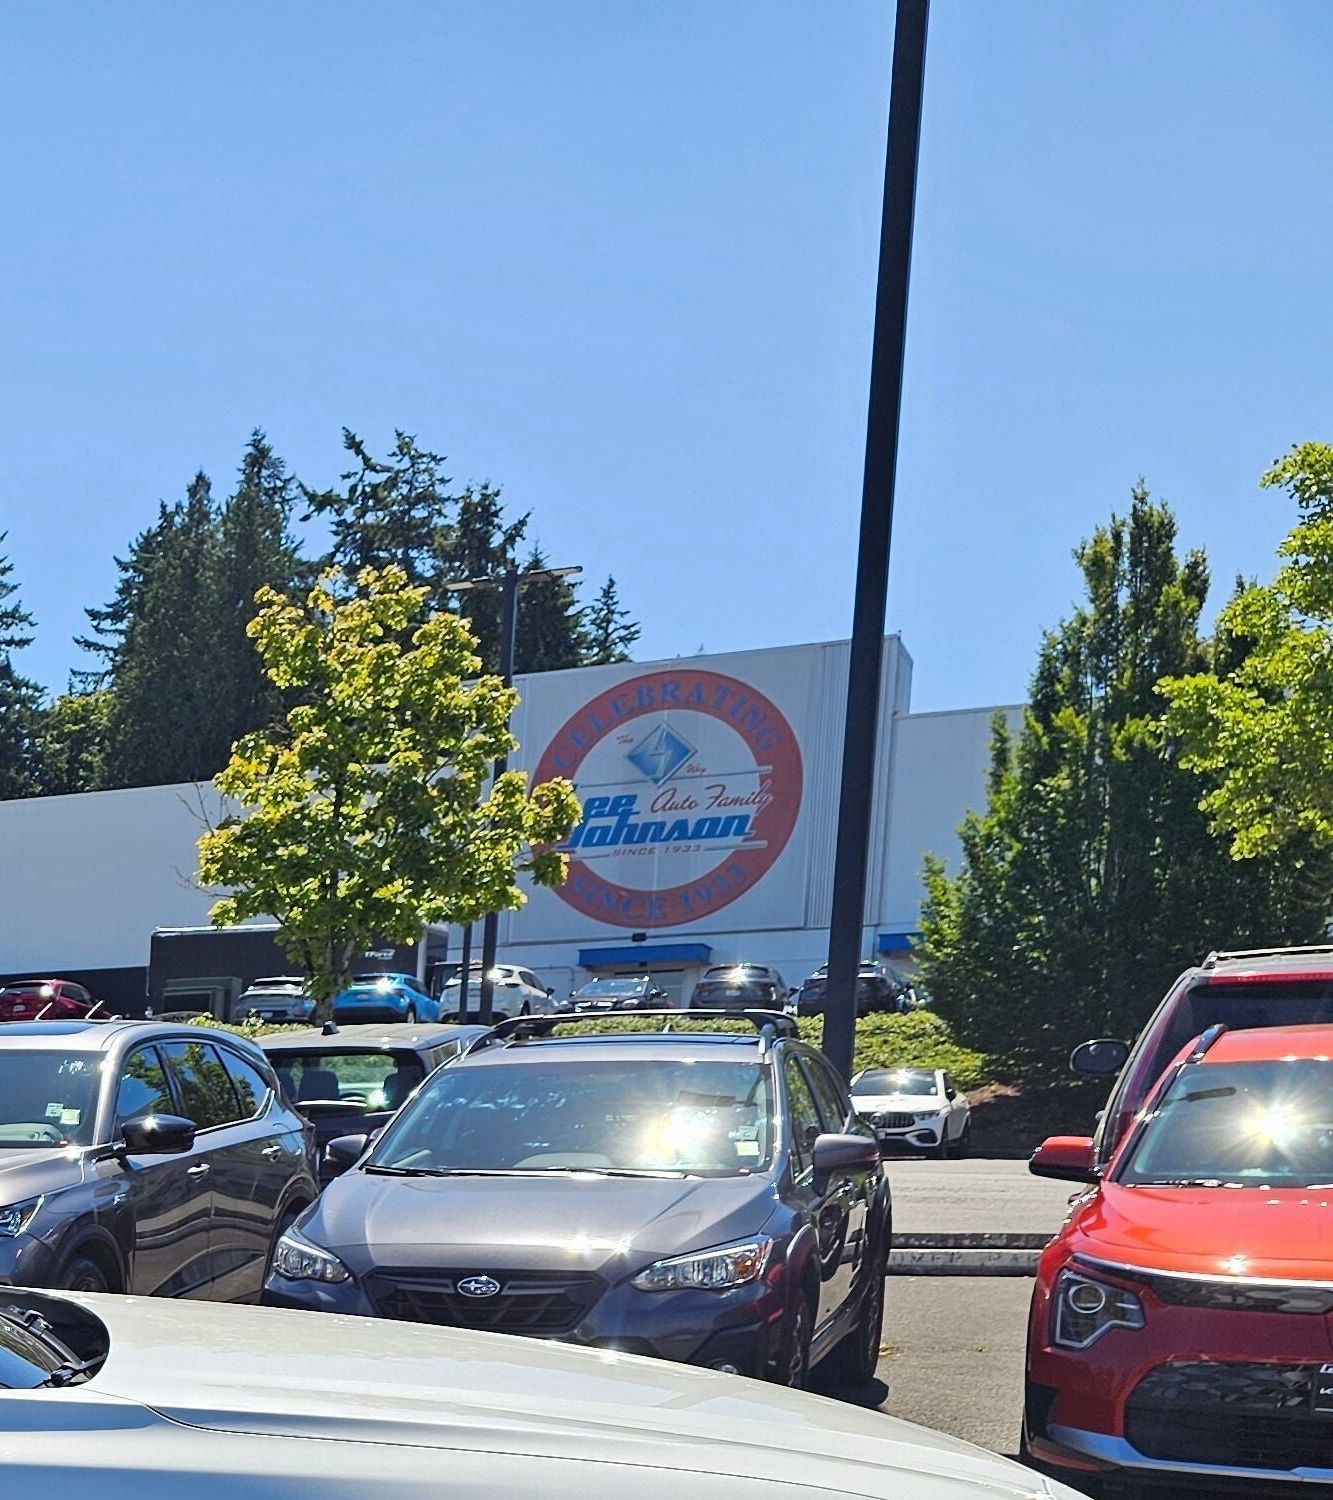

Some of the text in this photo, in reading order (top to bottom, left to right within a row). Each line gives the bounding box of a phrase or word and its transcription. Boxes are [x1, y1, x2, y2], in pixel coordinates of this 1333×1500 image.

[552, 680, 782, 769] CELEBRATING
[574, 783, 640, 819] ee
[650, 779, 774, 816] Auto Family
[556, 814, 757, 849] Johnson
[612, 844, 702, 857] SINCE 1933
[572, 863, 749, 920] SINCE 1933
